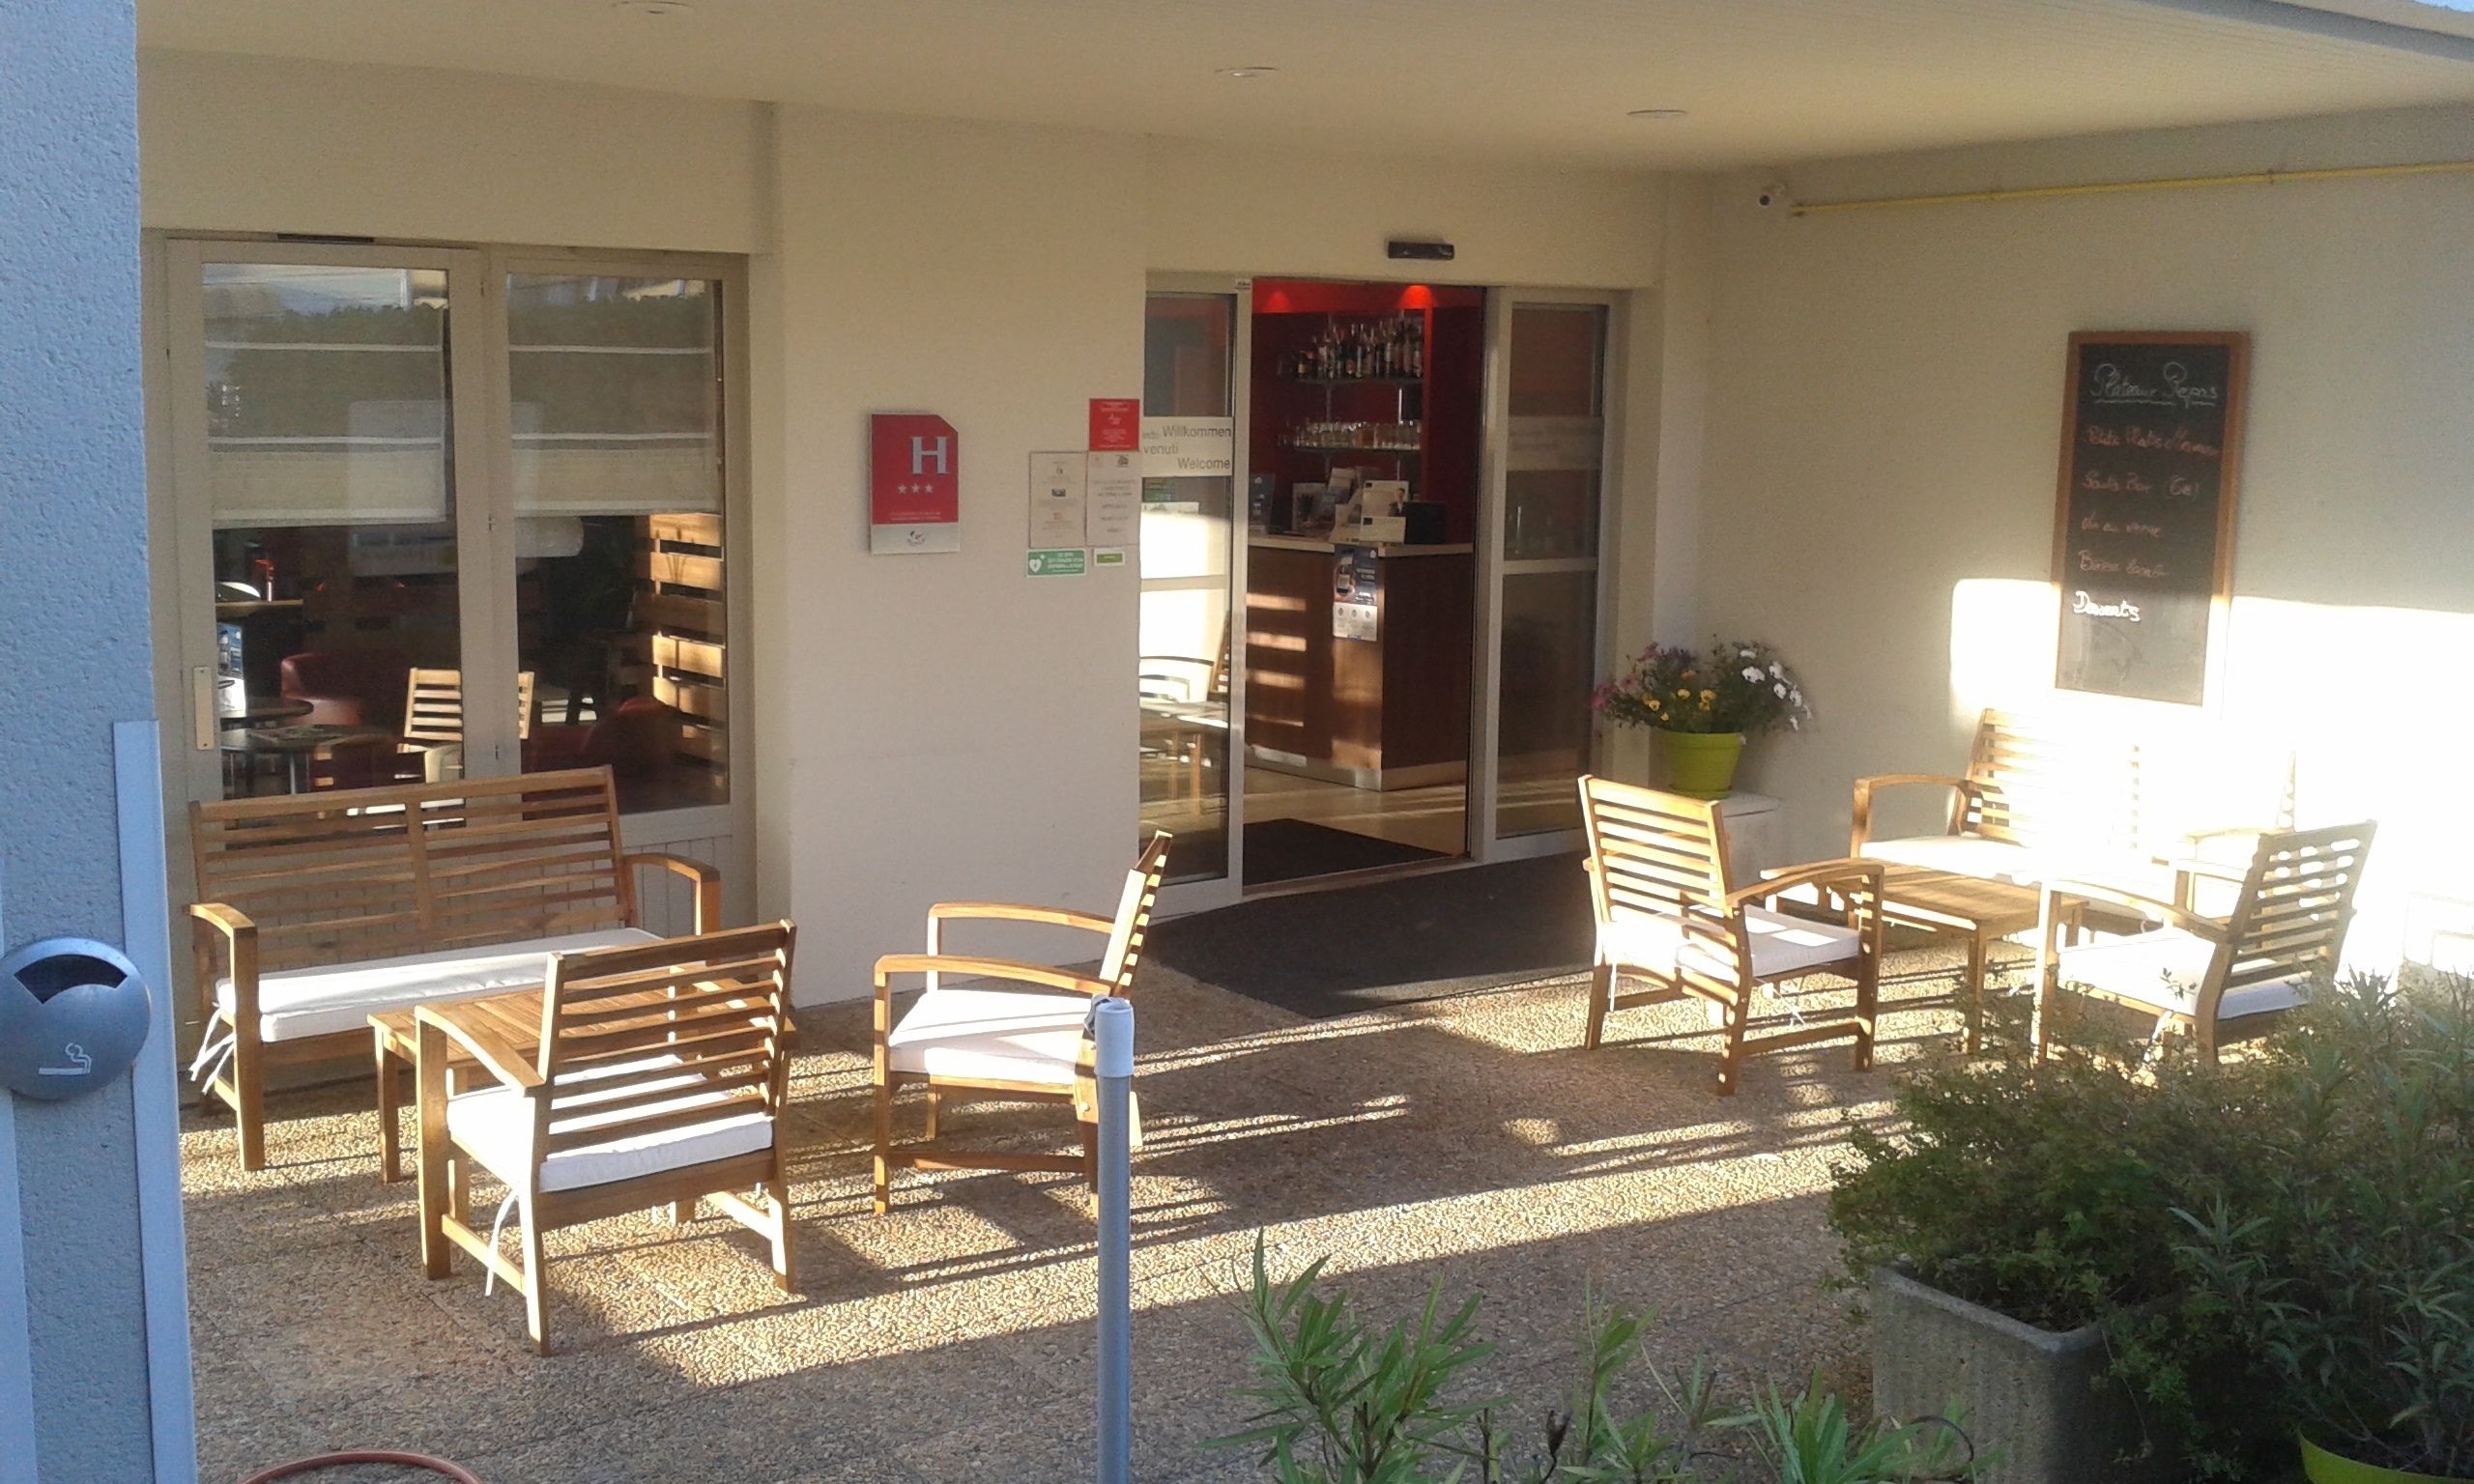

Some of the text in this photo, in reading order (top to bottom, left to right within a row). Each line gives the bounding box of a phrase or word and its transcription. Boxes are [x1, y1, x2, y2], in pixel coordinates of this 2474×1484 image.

[1163, 425, 1231, 438] Willkommen
[910, 436, 949, 475] H
[1177, 457, 1230, 470] Welcome
